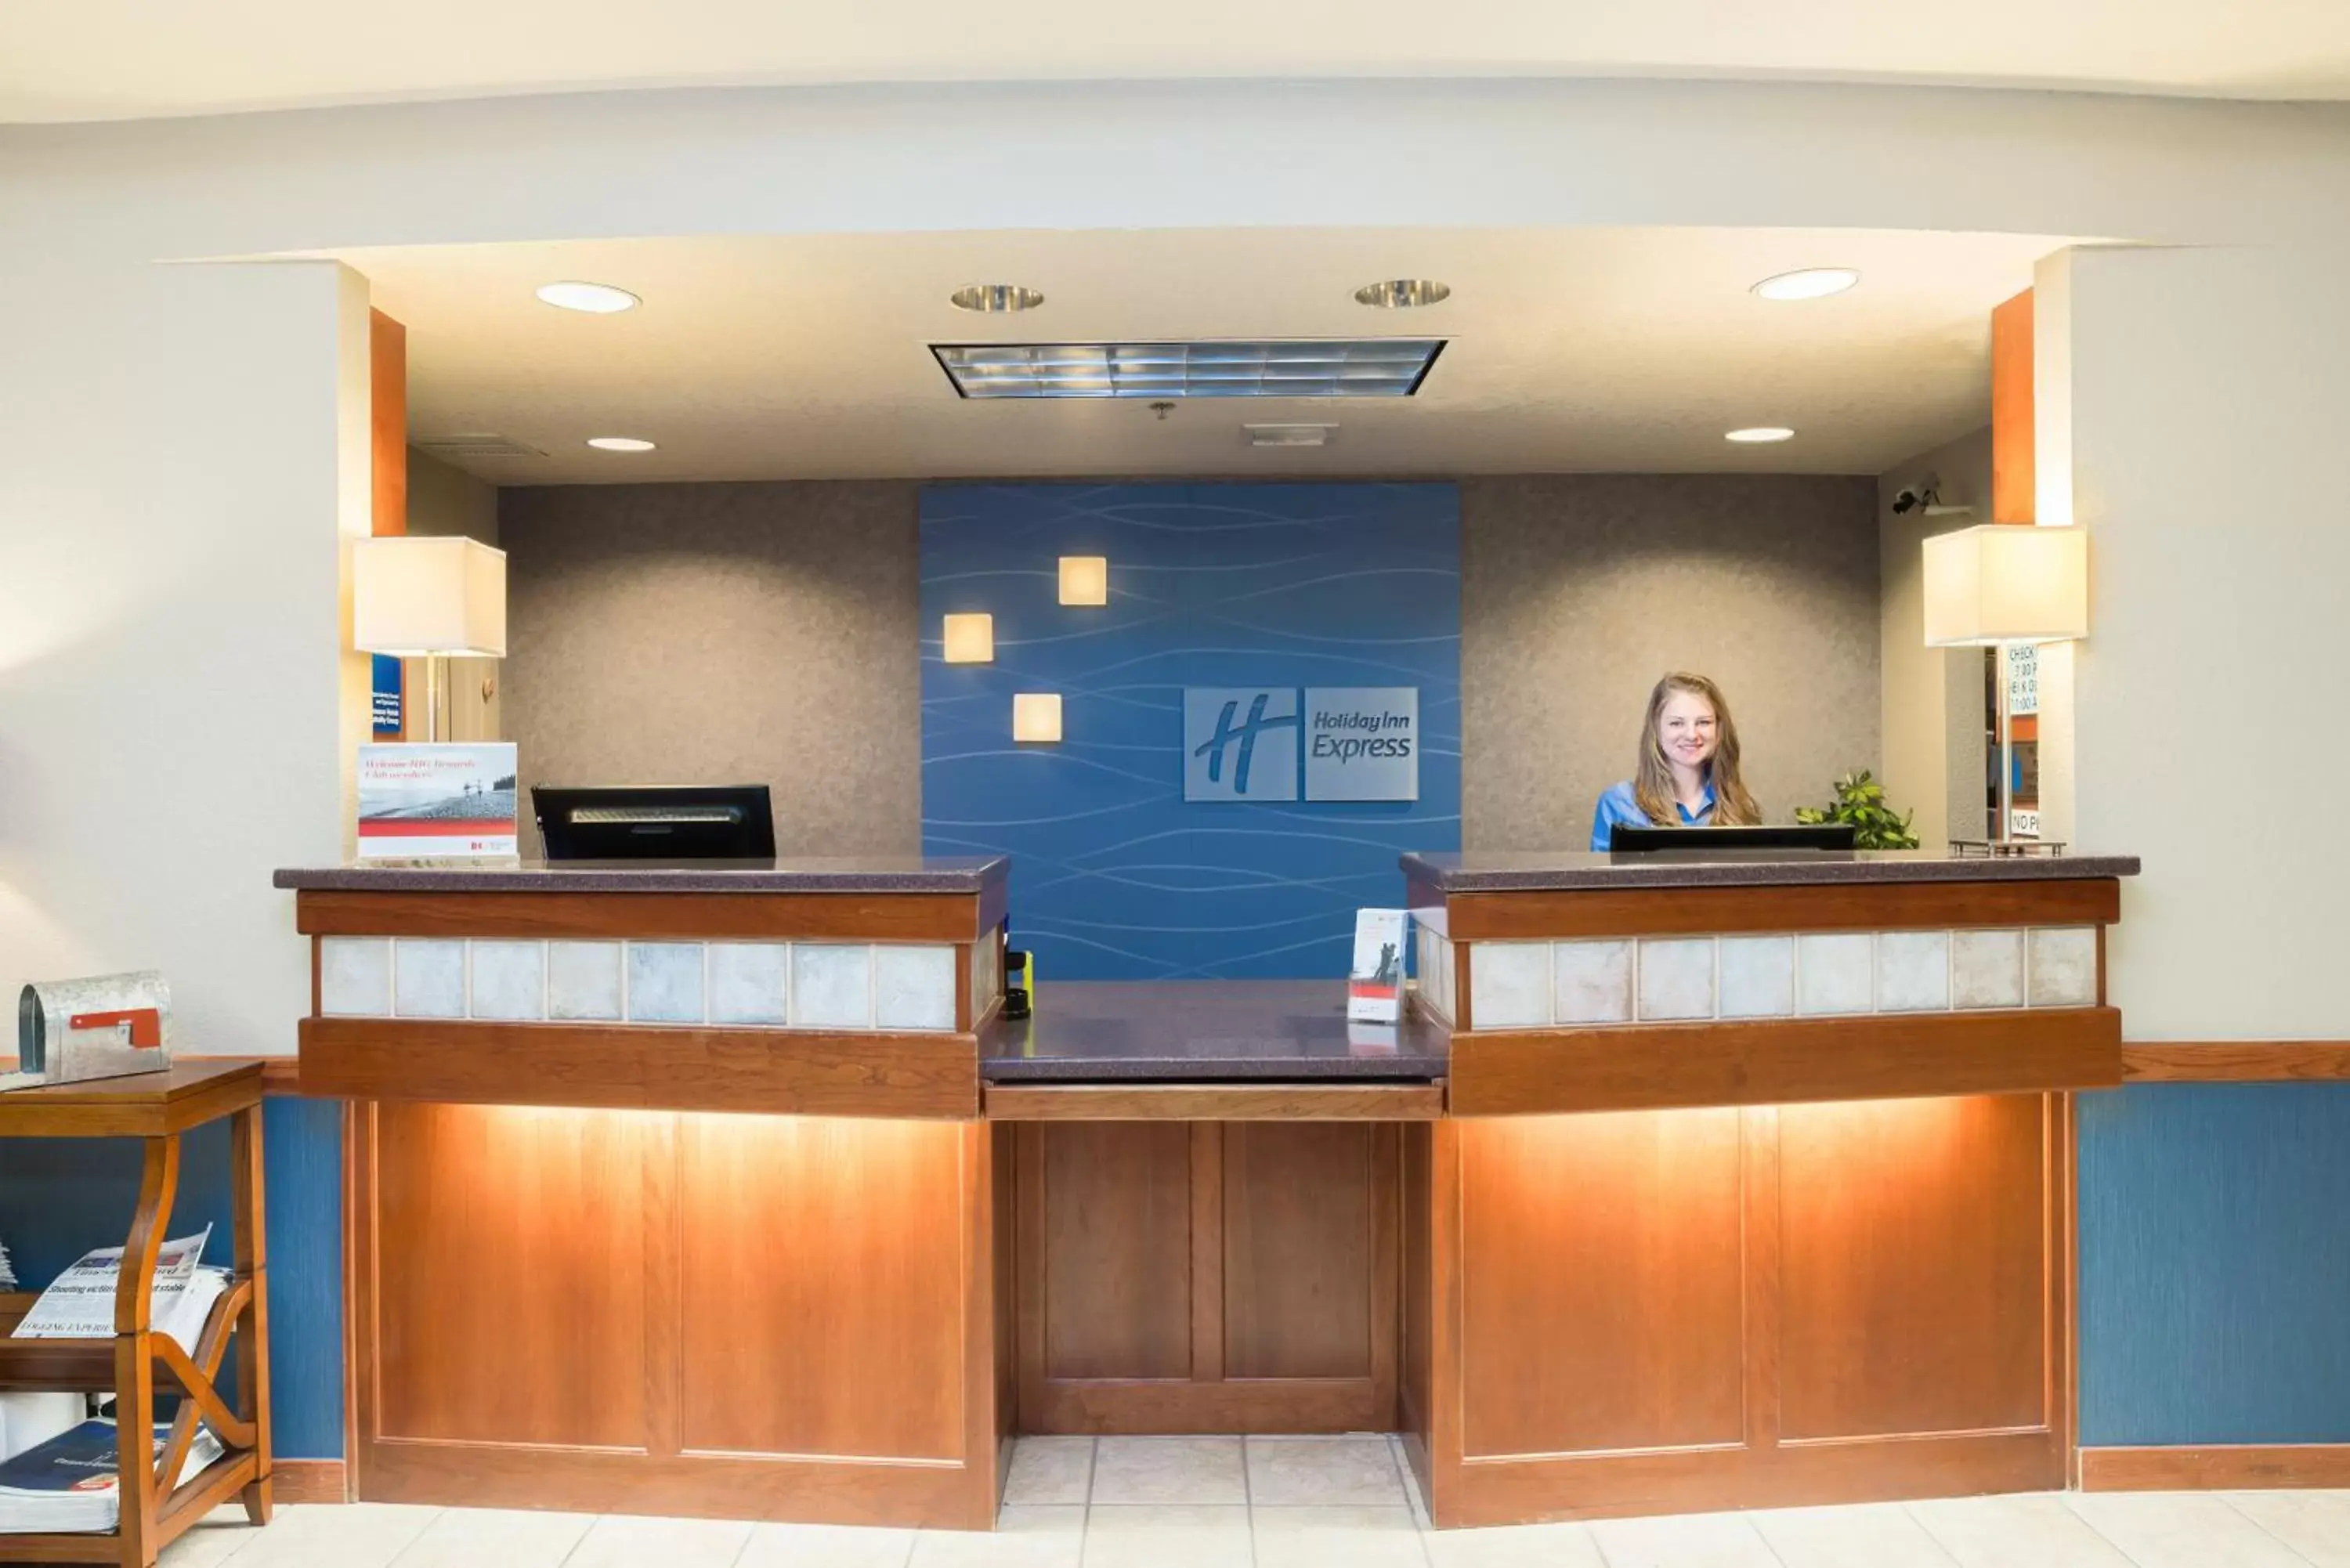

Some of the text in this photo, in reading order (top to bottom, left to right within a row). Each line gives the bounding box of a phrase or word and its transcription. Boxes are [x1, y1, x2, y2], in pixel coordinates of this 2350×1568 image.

[1314, 711, 1410, 732] Holiday Inn
[1312, 734, 1411, 764] Express
